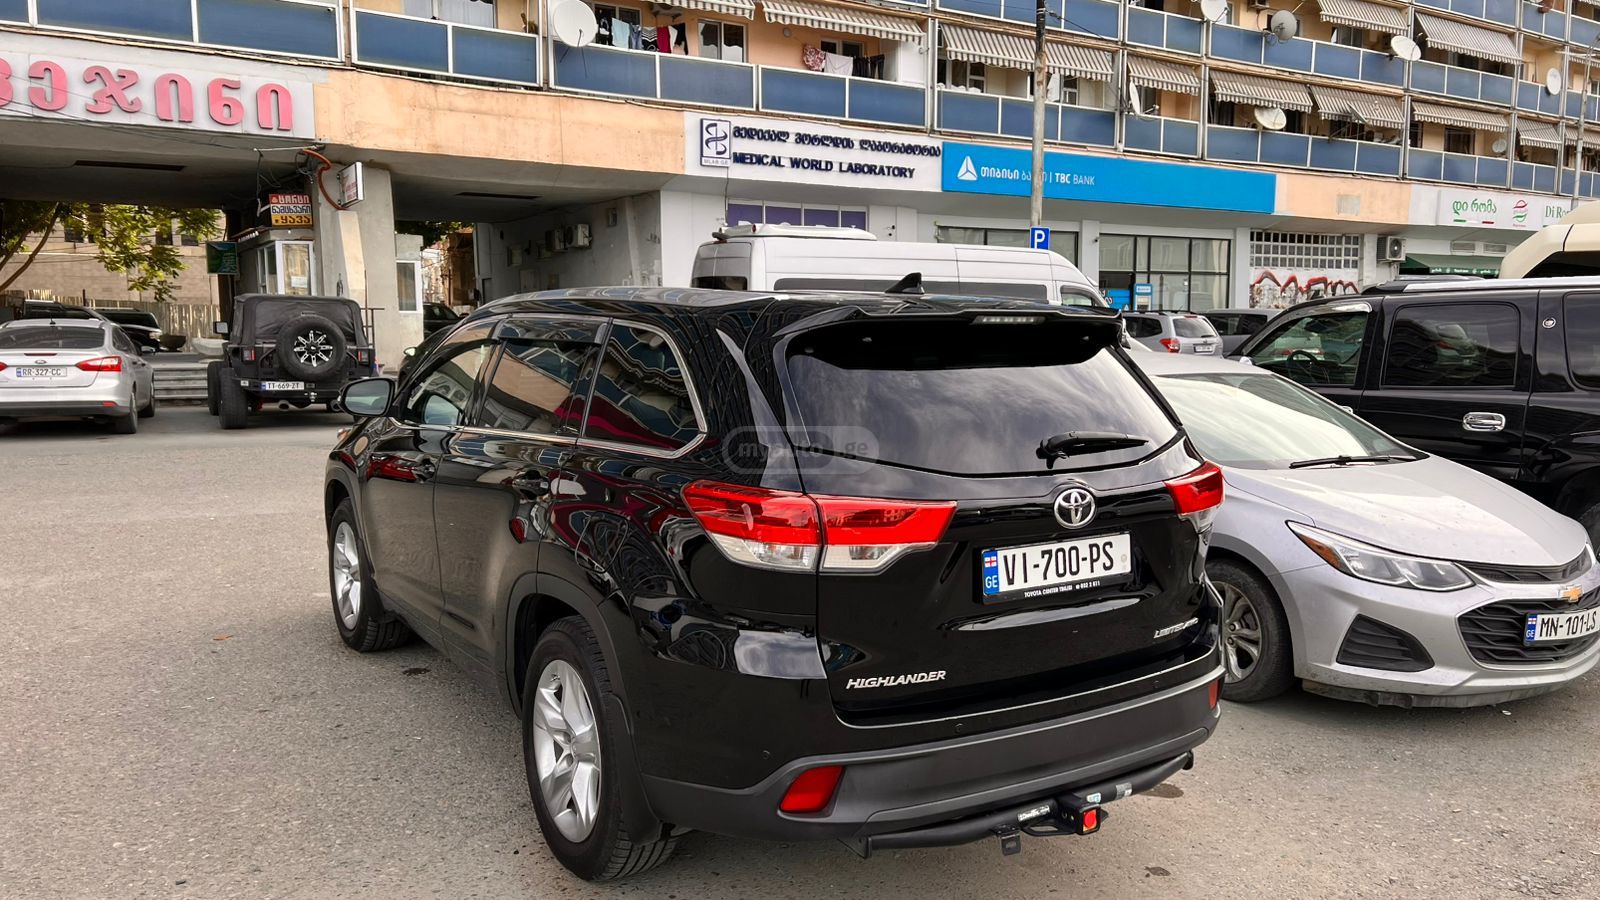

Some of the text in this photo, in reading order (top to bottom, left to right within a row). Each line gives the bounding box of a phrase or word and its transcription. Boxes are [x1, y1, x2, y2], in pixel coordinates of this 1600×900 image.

[733, 152, 915, 178] MEDICAL WORLD LABORATORY
[980, 166, 1019, 180] თიბისი
[1055, 172, 1095, 186] TBC BANK
[1452, 198, 1497, 216] დი რომა
[1545, 205, 1555, 218] Di
[280, 215, 311, 224] ყავა
[1034, 230, 1046, 246] P
[1003, 541, 1114, 586] VI-700-PS
[985, 575, 998, 588] GE
[1024, 589, 1042, 598] TOYOTA
[1540, 611, 1597, 638] MN-101-LS
[1525, 630, 1535, 638] GE
[846, 670, 947, 690] HIGHLANDER
